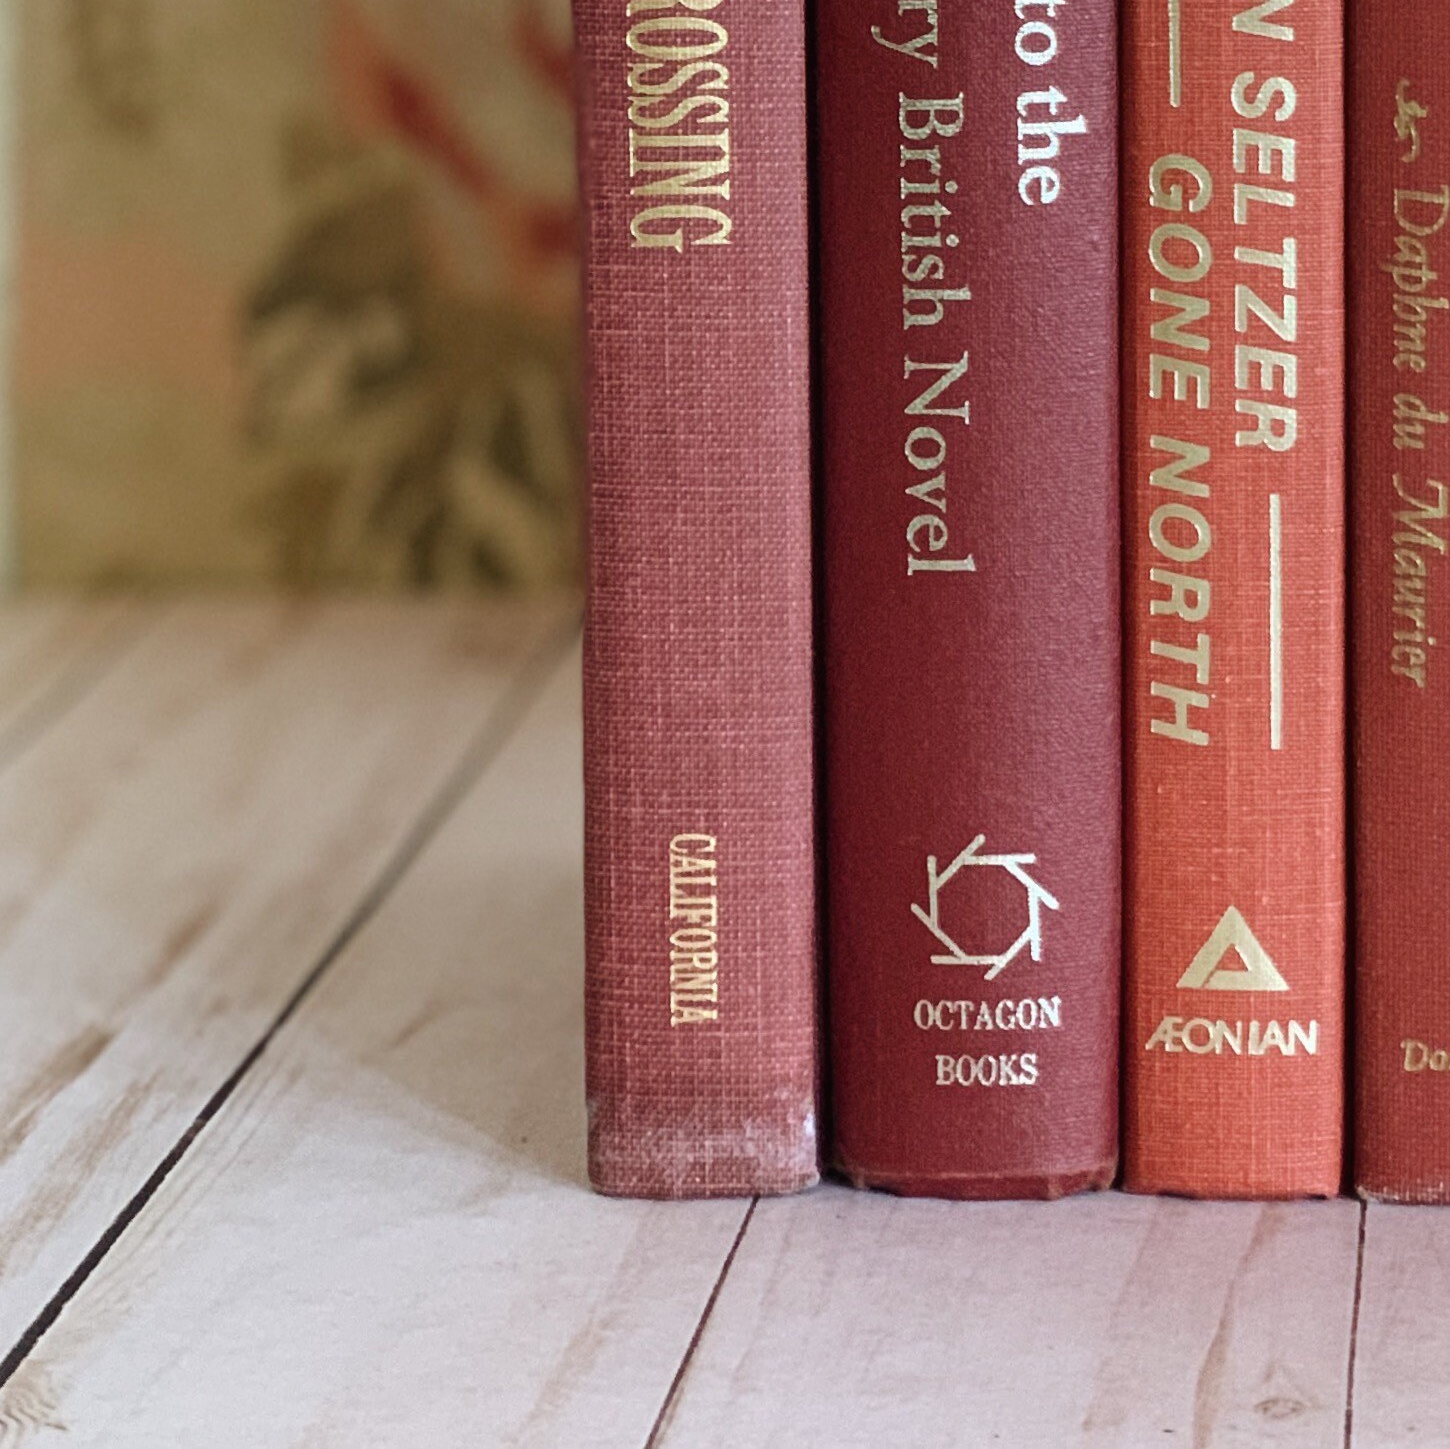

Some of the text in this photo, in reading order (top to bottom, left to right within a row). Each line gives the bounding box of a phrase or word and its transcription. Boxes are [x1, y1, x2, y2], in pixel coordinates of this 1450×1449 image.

[896, 91, 973, 330] British
[1015, 86, 1090, 207] the
[1230, 70, 1298, 453] SELTZER
[902, 352, 977, 577] Novel
[1148, 153, 1213, 747] GONE NORTH
[1380, 184, 1450, 690] Daphne du Maurier
[668, 832, 719, 1027] CALIFORNIA
[913, 997, 1063, 1032] OCTAGON
[935, 1053, 1039, 1087] BOOKS
